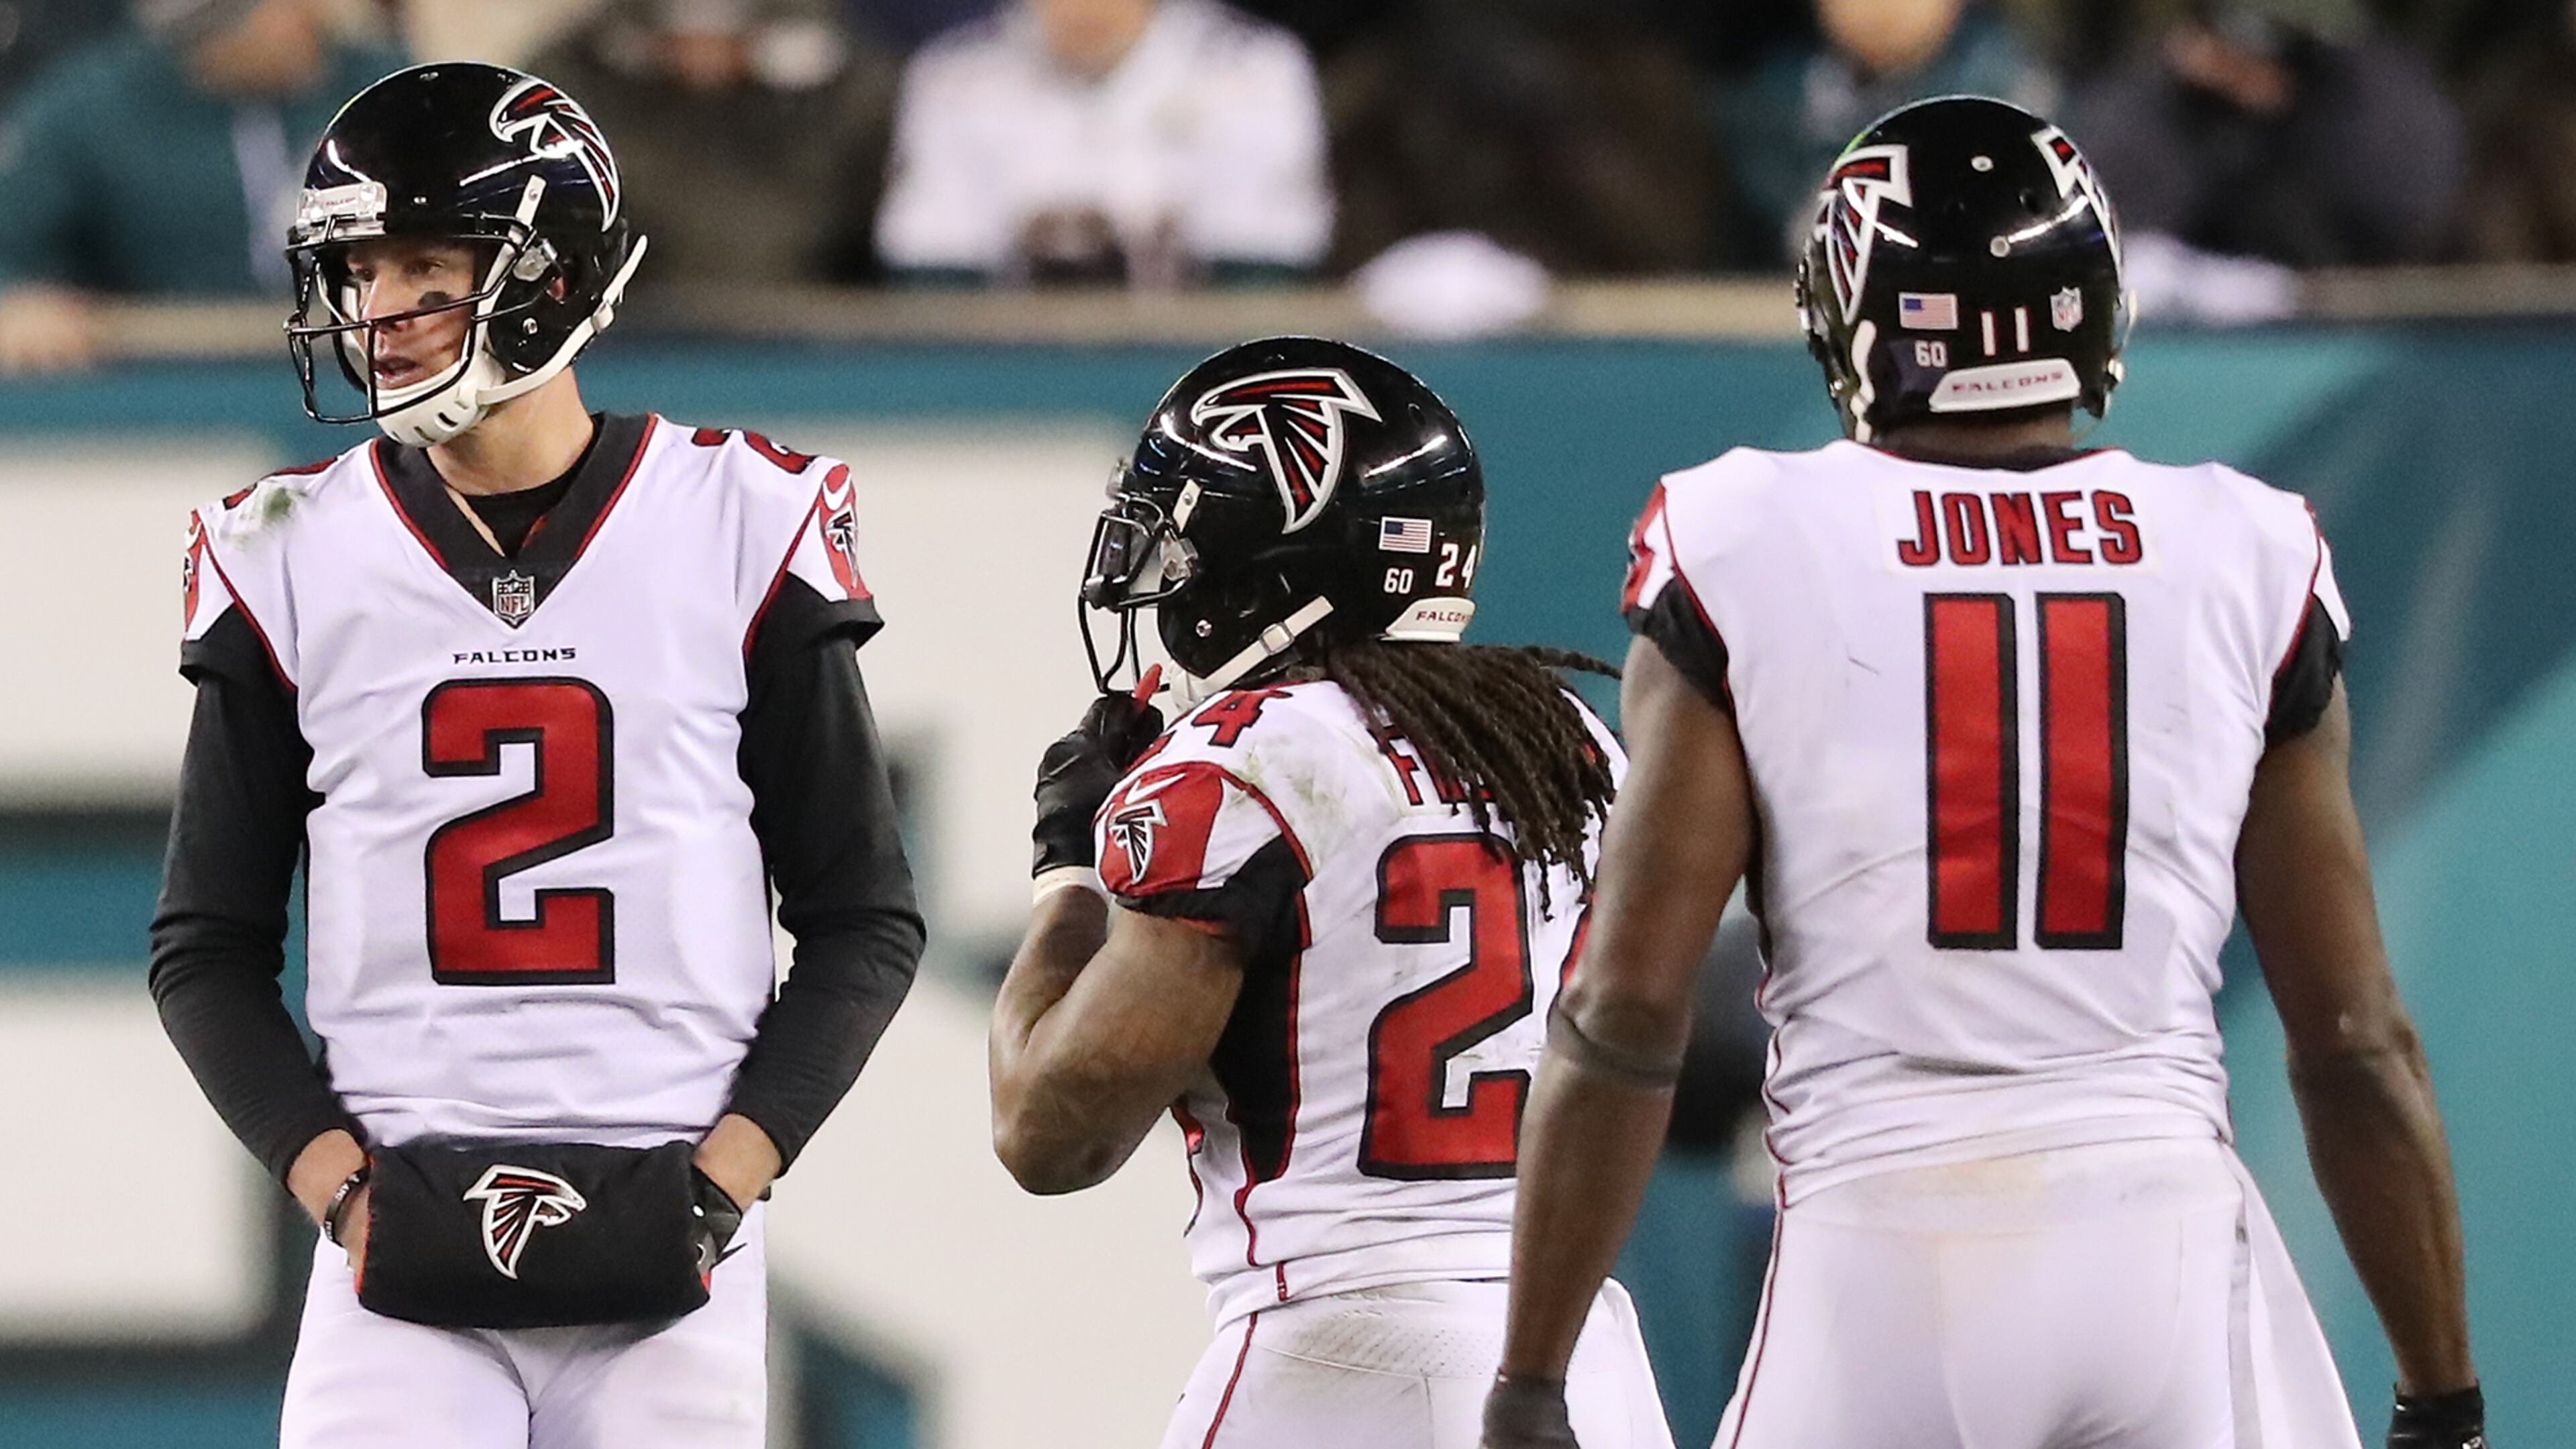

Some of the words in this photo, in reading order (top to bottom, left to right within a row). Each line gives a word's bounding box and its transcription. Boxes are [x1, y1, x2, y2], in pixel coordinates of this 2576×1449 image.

[1914, 339, 1947, 368] 60
[1980, 307, 2031, 356] 11
[1951, 371, 2063, 392] FALCONS
[1896, 490, 2143, 566] JONES
[1383, 568, 1414, 594] 60
[1434, 543, 1477, 589] 24
[500, 594, 531, 614] NFL
[452, 647, 576, 665] FALCONS
[1923, 591, 2129, 951] 11
[421, 676, 616, 985] 2
[1356, 832, 1600, 1181] 2
